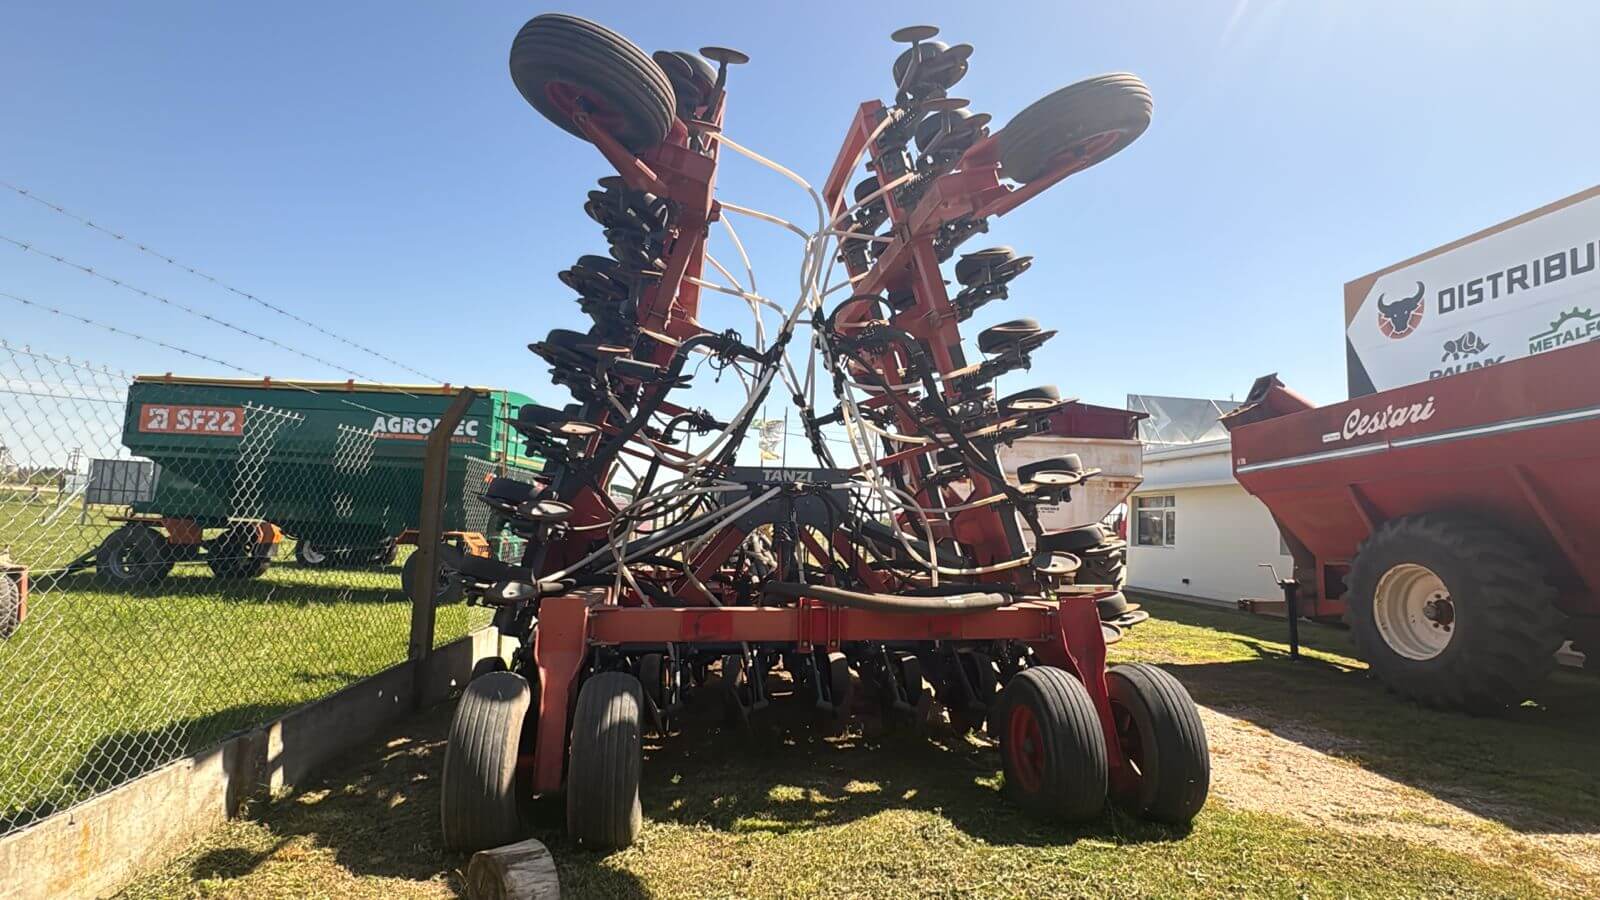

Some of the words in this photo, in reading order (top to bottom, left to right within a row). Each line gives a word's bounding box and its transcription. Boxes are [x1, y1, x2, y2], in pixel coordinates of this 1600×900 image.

[1438, 239, 1600, 315] DISTRIBU
[175, 409, 236, 432] SF22
[371, 416, 479, 437] AGROEC
[1342, 396, 1436, 440] Cestari
[762, 470, 813, 482] TANZI
